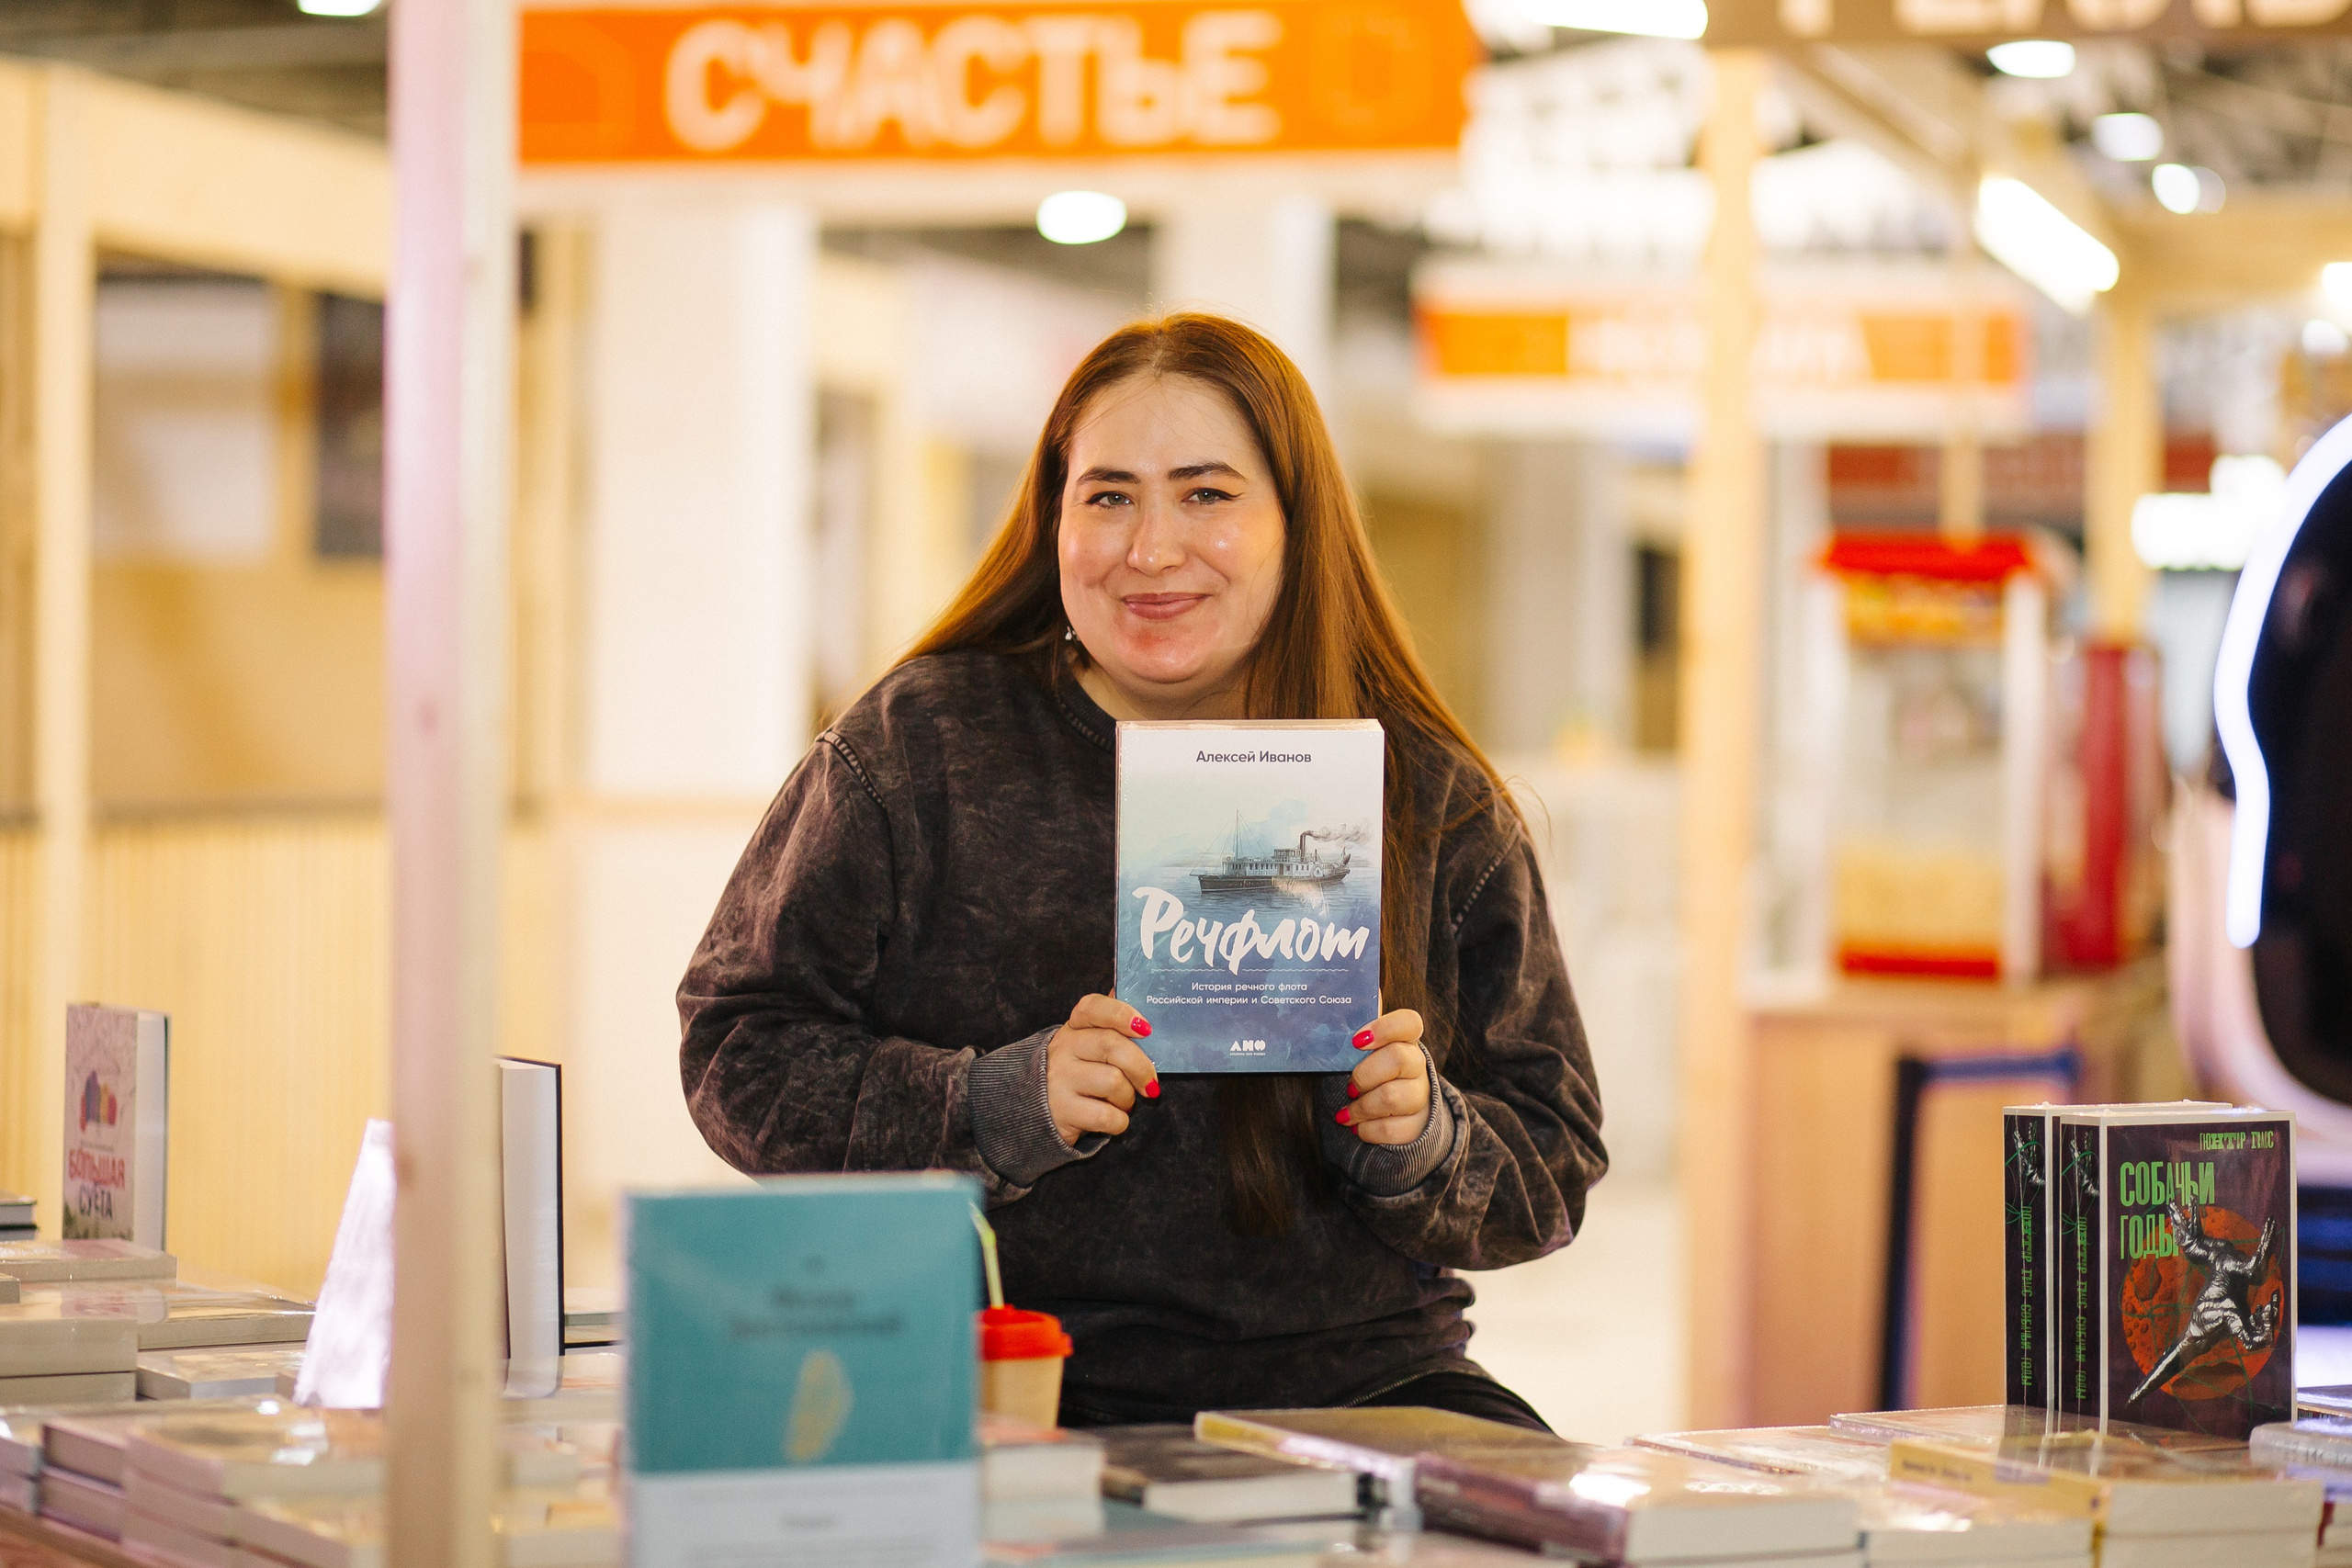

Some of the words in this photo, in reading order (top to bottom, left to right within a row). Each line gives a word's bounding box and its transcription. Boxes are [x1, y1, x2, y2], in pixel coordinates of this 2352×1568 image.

[665, 9, 1283, 152] СЧАСТЬЕ
[1195, 749, 1256, 763] Алексей
[1259, 750, 1312, 763] Иванов
[1131, 886, 1370, 975] Речфлот
[1146, 994, 1204, 1006] Российской
[1206, 997, 1249, 1006] империи
[1261, 995, 1317, 1005] Советского
[1319, 995, 1352, 1005] Союза
[1191, 982, 1232, 992] История
[1235, 984, 1275, 992] речного
[1278, 982, 1307, 992] флота
[68, 1148, 126, 1190] БОЛЬШАЯ
[2120, 1161, 2215, 1207] СОБАЧЬИ
[79, 1182, 113, 1219] СУЕТА
[2120, 1213, 2179, 1260] ГОДЫ
